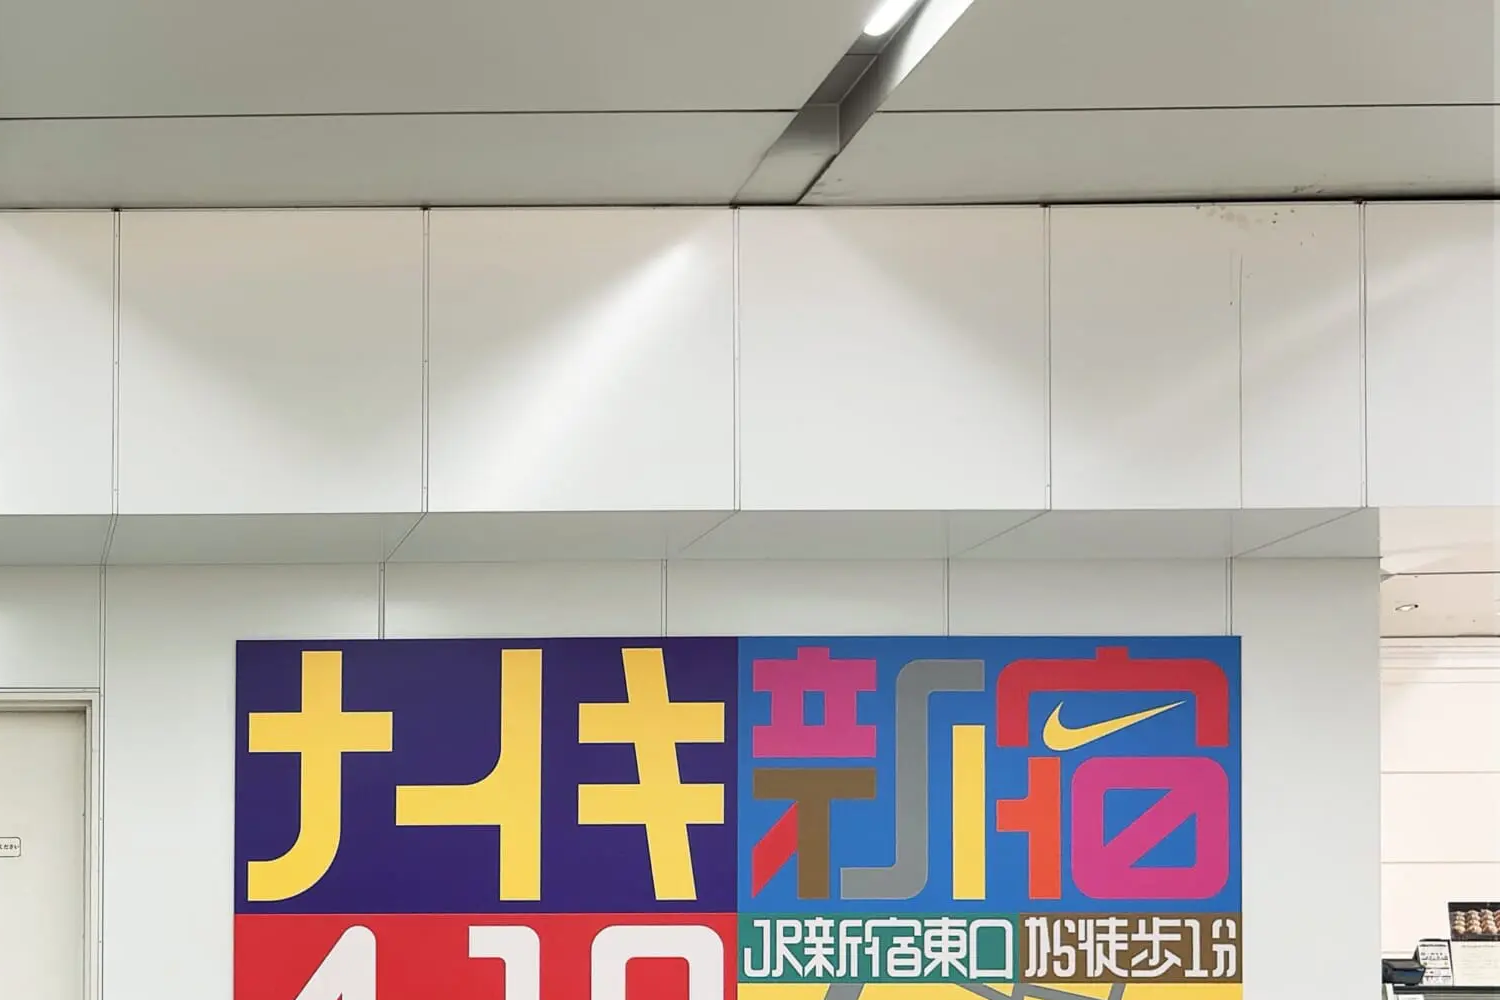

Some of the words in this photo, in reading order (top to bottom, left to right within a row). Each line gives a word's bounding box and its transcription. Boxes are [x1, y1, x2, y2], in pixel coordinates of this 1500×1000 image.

[247, 648, 725, 901] ナイキ
[752, 646, 1230, 900] 新宿
